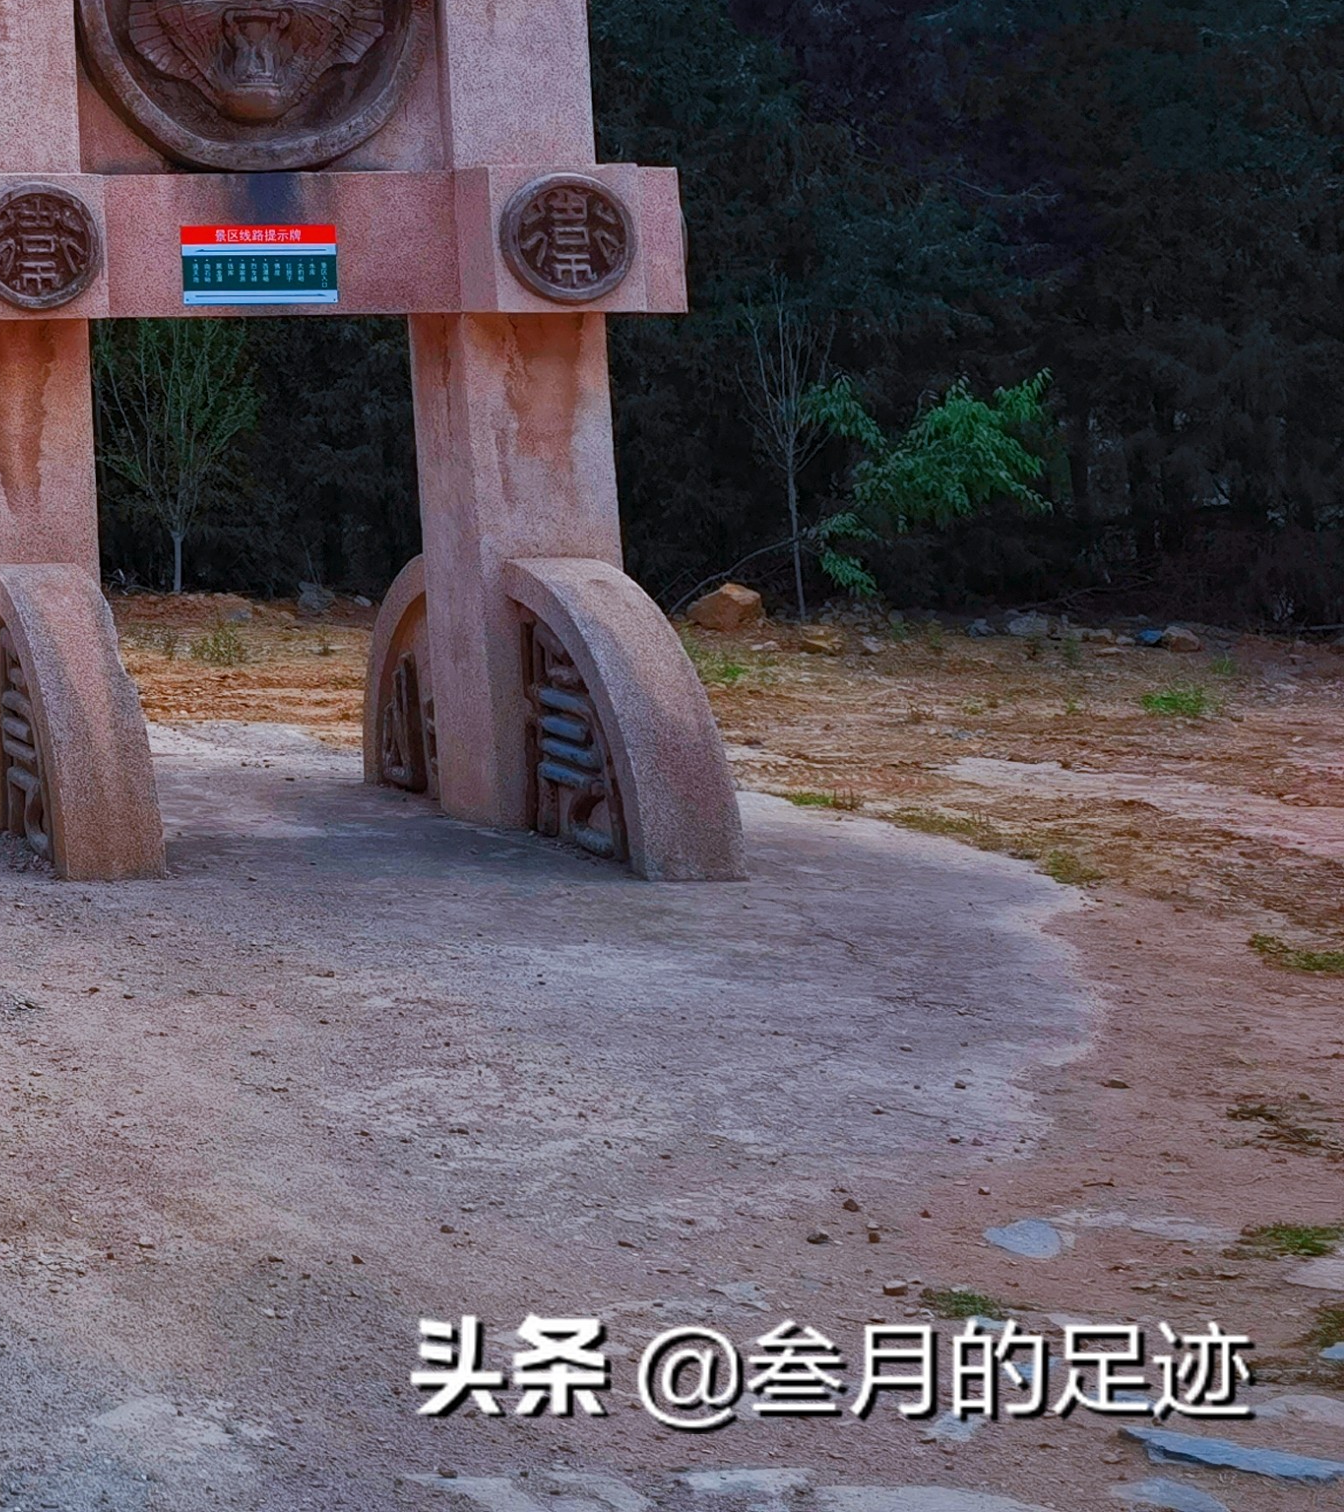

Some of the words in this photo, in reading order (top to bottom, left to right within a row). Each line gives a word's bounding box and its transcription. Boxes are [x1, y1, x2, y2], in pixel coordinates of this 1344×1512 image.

[215, 229, 302, 242] 景区线路提示牌
